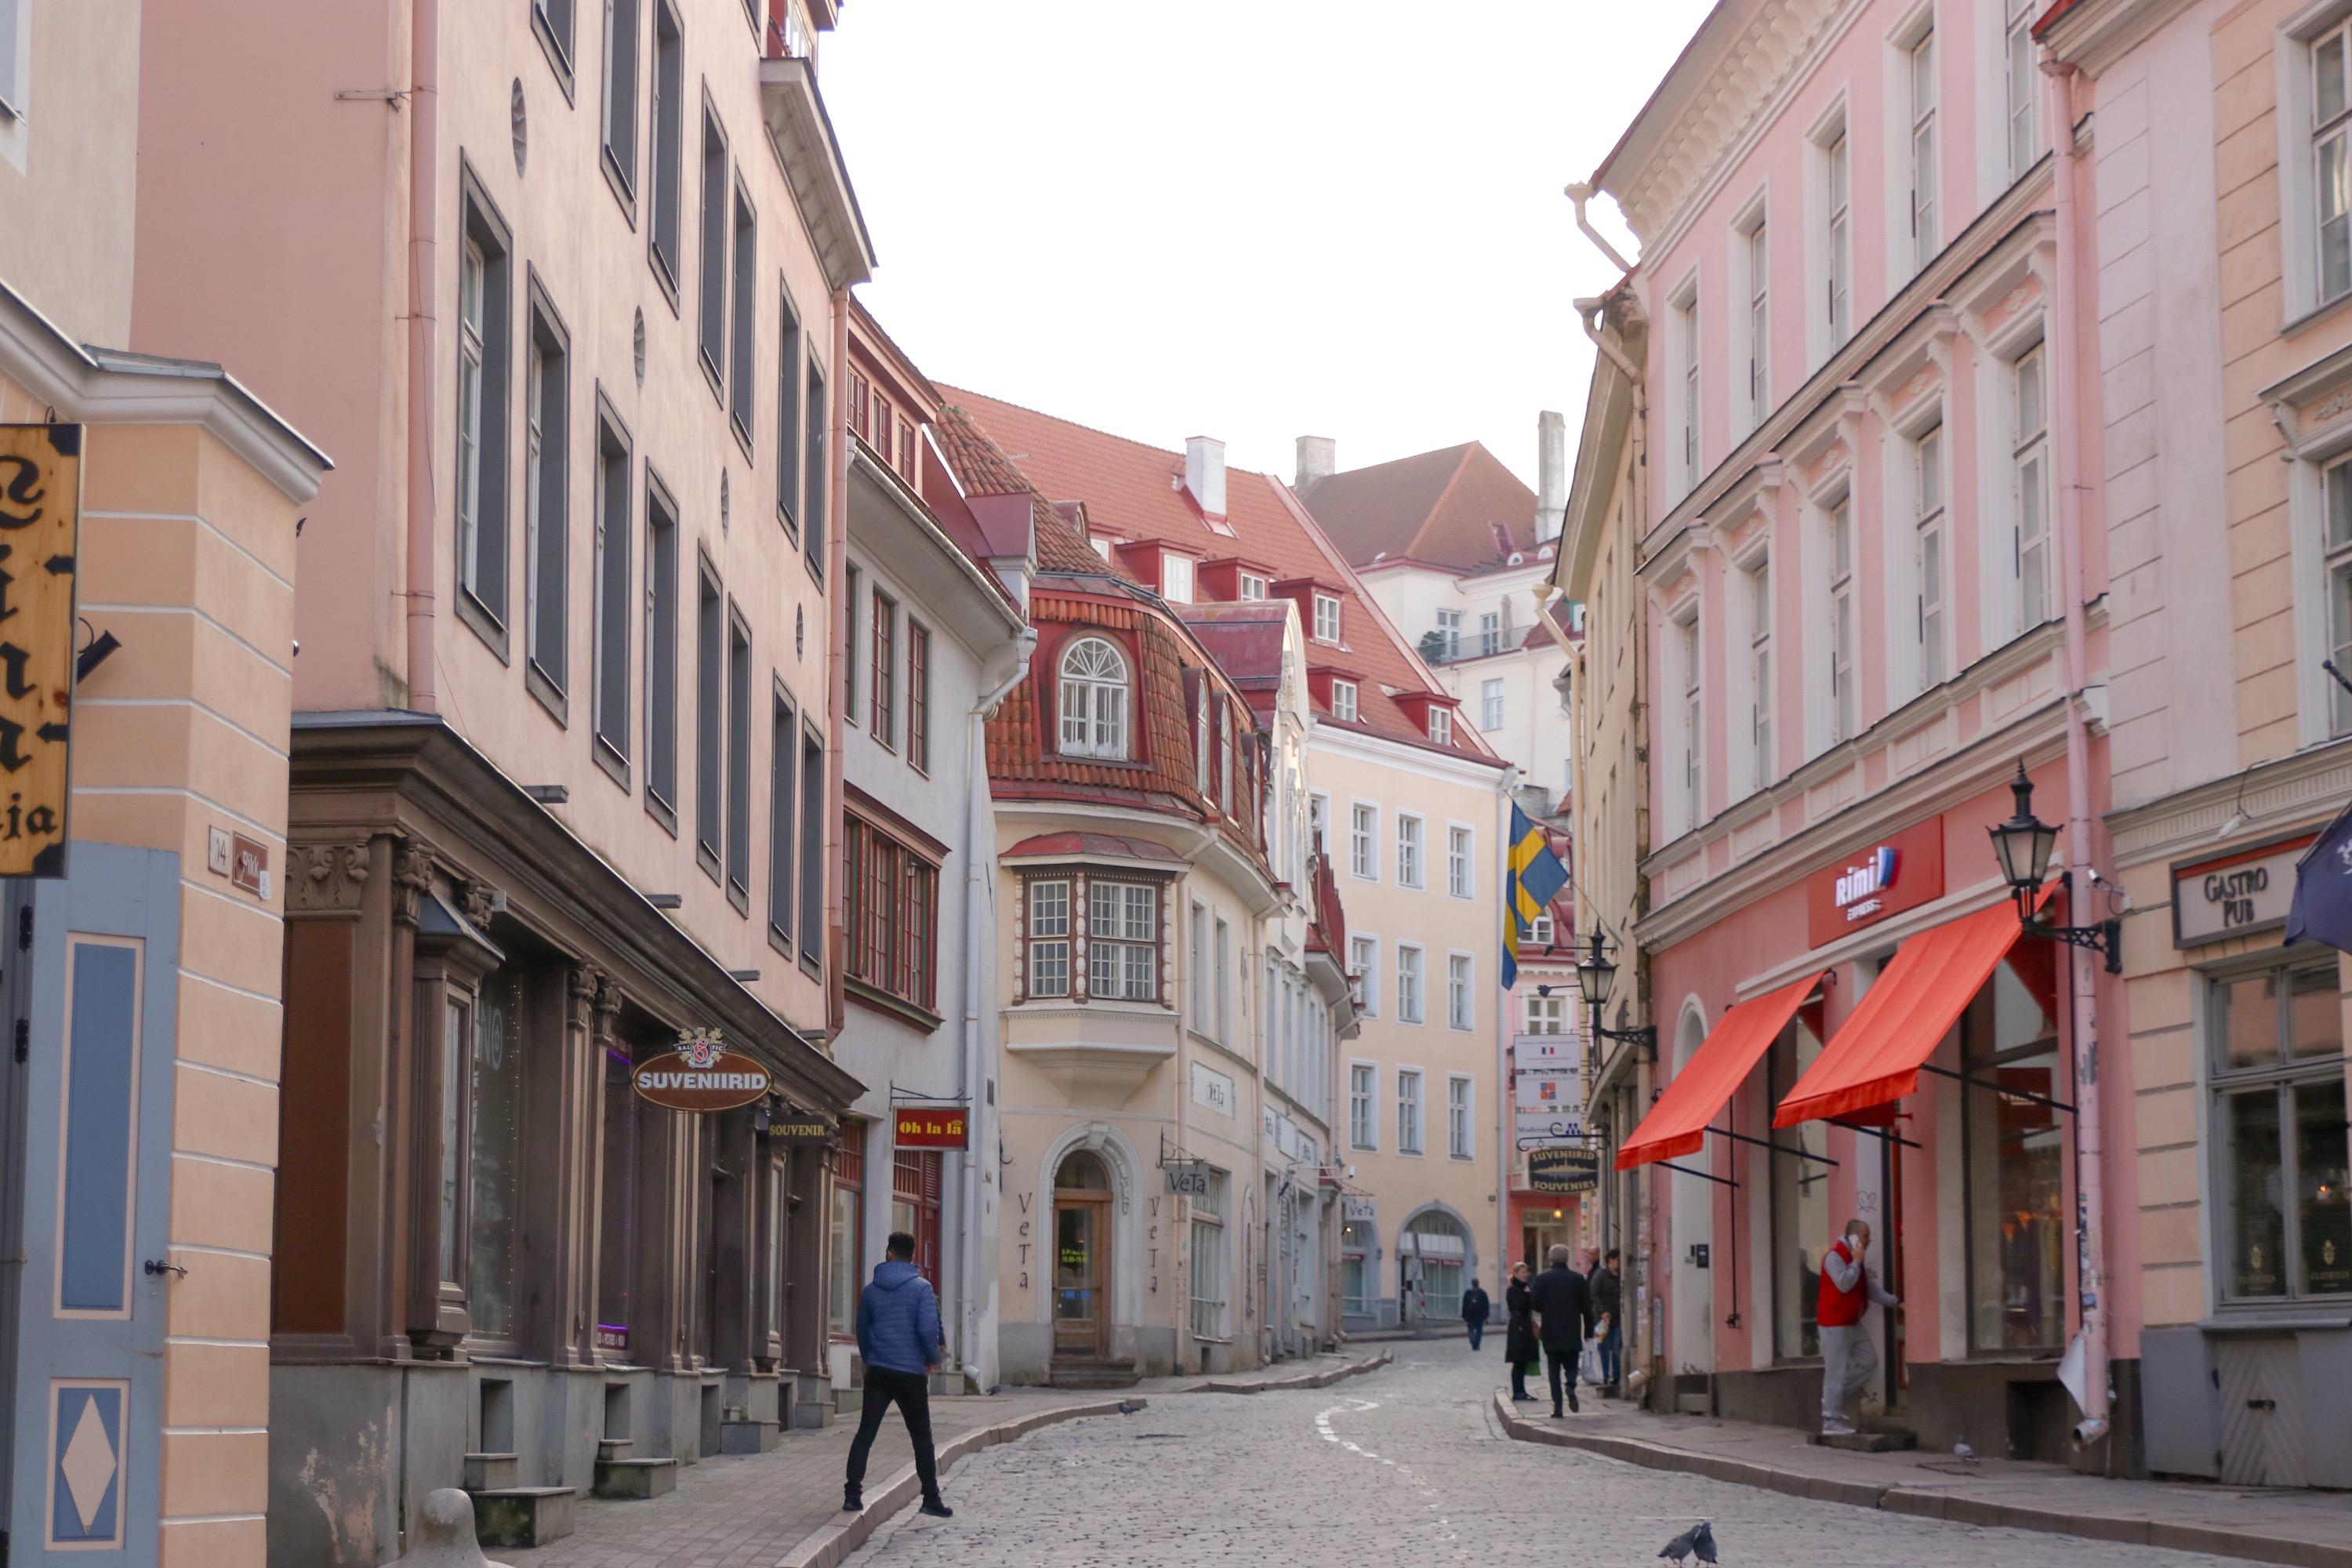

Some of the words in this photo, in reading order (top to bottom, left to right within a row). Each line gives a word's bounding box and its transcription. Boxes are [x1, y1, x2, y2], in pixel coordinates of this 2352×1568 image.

[216, 837, 226, 866] 14
[242, 850, 260, 878] Pikk
[2205, 867, 2268, 903] GASTRO
[2223, 898, 2255, 927] PUB
[638, 1072, 767, 1091] SUVENIIRID
[769, 1124, 826, 1136] SOUVENIR
[899, 1121, 921, 1134] Oh
[927, 1122, 941, 1134] la
[1531, 1149, 1595, 1163] SUVENIIRID
[1169, 1173, 1205, 1194] VeTa
[1534, 1180, 1595, 1192] SOUVENIRS
